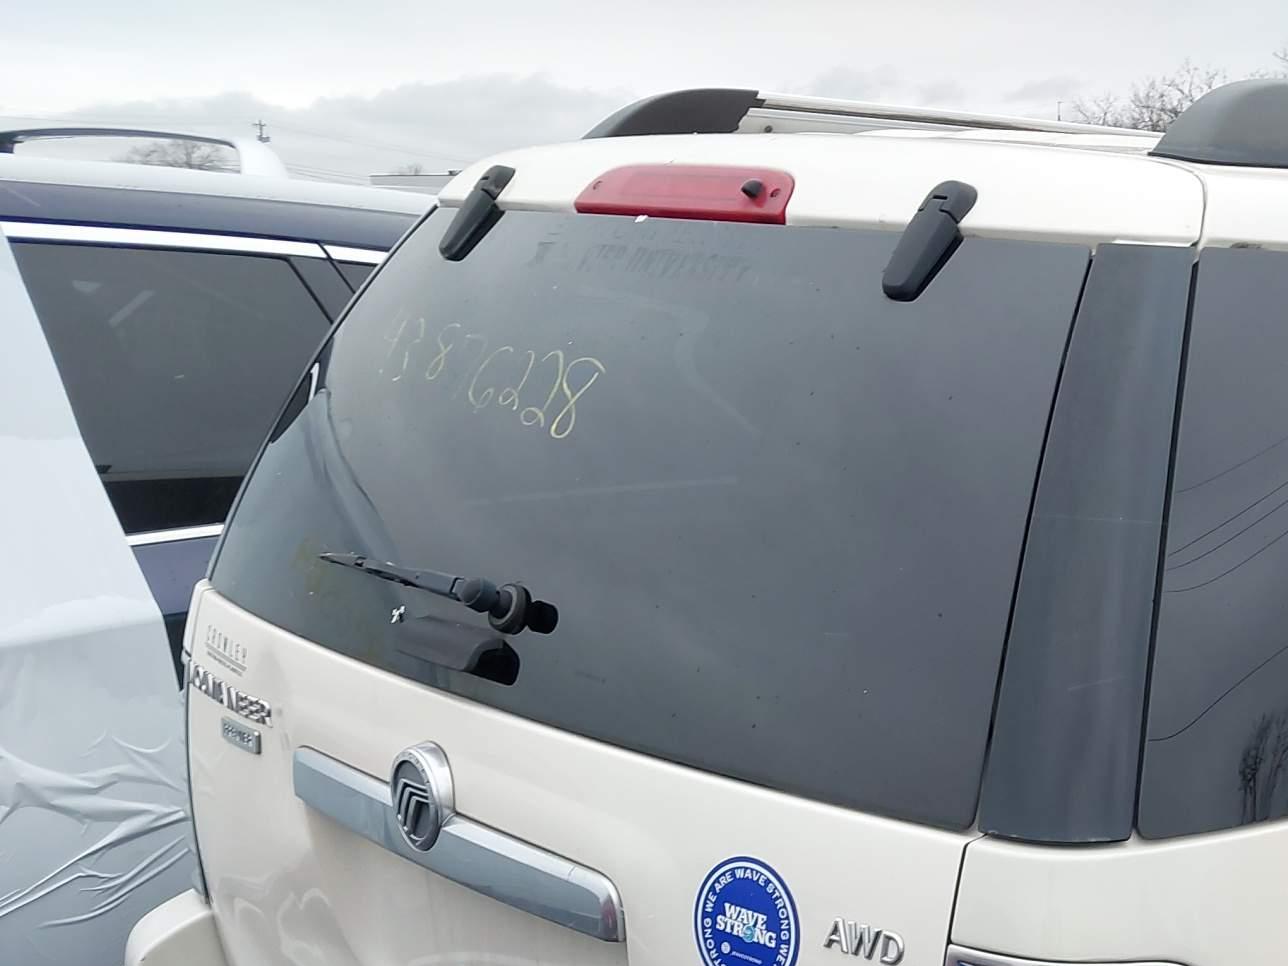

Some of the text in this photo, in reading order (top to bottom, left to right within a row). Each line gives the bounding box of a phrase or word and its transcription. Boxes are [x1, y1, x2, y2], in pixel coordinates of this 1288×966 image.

[714, 870, 734, 893] ARE
[734, 867, 767, 887] WAVE
[704, 891, 718, 913] WE
[766, 882, 790, 940] STRONG
[723, 902, 768, 930] WAVE
[715, 914, 777, 949] STRONG
[823, 916, 905, 966] AWD
[776, 943, 790, 966] WE
